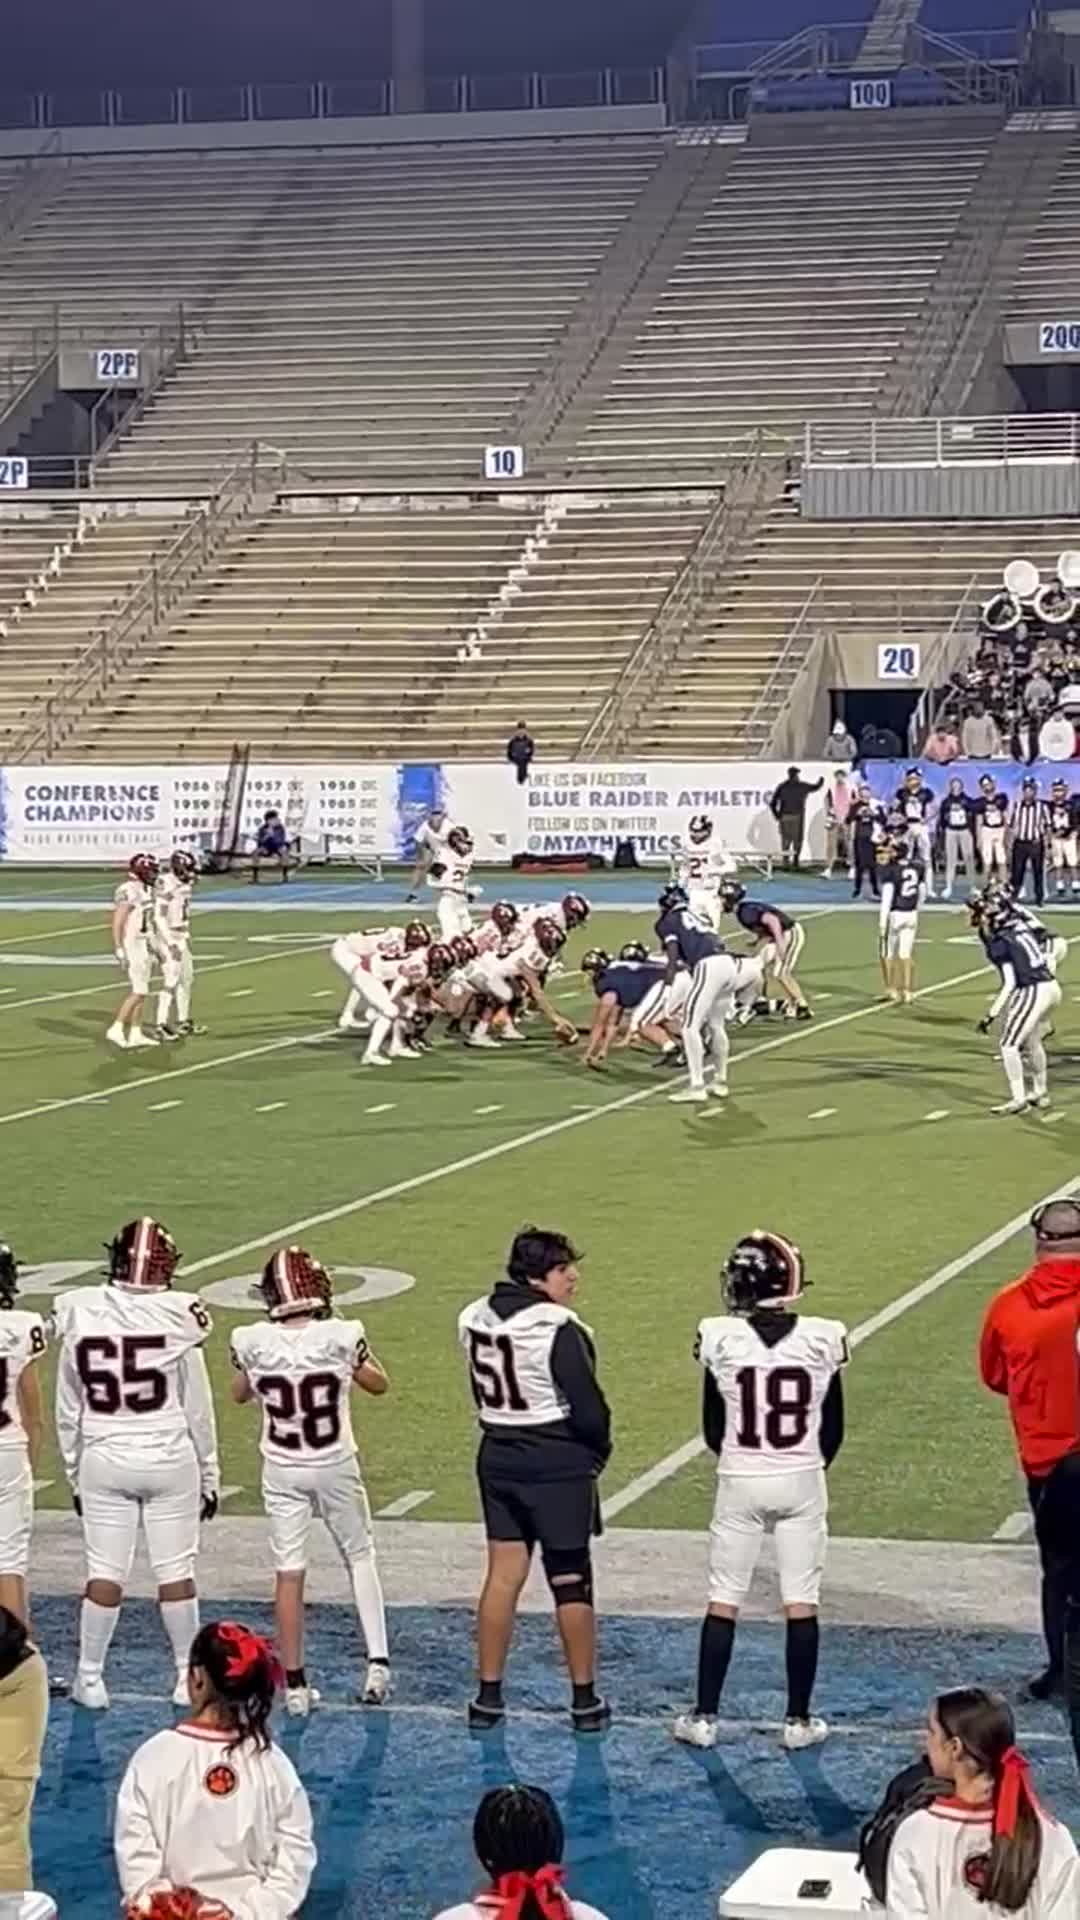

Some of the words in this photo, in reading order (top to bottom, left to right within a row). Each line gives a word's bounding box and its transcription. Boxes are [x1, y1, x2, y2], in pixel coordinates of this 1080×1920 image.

[100, 352, 136, 375] 2PP
[0, 461, 24, 485] 2P
[491, 450, 515, 475] 1Q
[884, 648, 914, 676] 2Q
[24, 785, 160, 801] CONFERENCE
[528, 791, 580, 807] BLUE
[590, 791, 668, 807] RAIDER
[677, 791, 774, 807] ATHLETIC
[24, 805, 156, 821] CHAMPIONS
[901, 868, 918, 897] 2
[188, 1302, 208, 1328] 6
[30, 1326, 46, 1353] 8
[354, 1337, 370, 1365] 2
[75, 1336, 168, 1414] 65
[469, 1327, 529, 1411] 51
[256, 1372, 342, 1449] 28
[736, 1366, 812, 1450] 18
